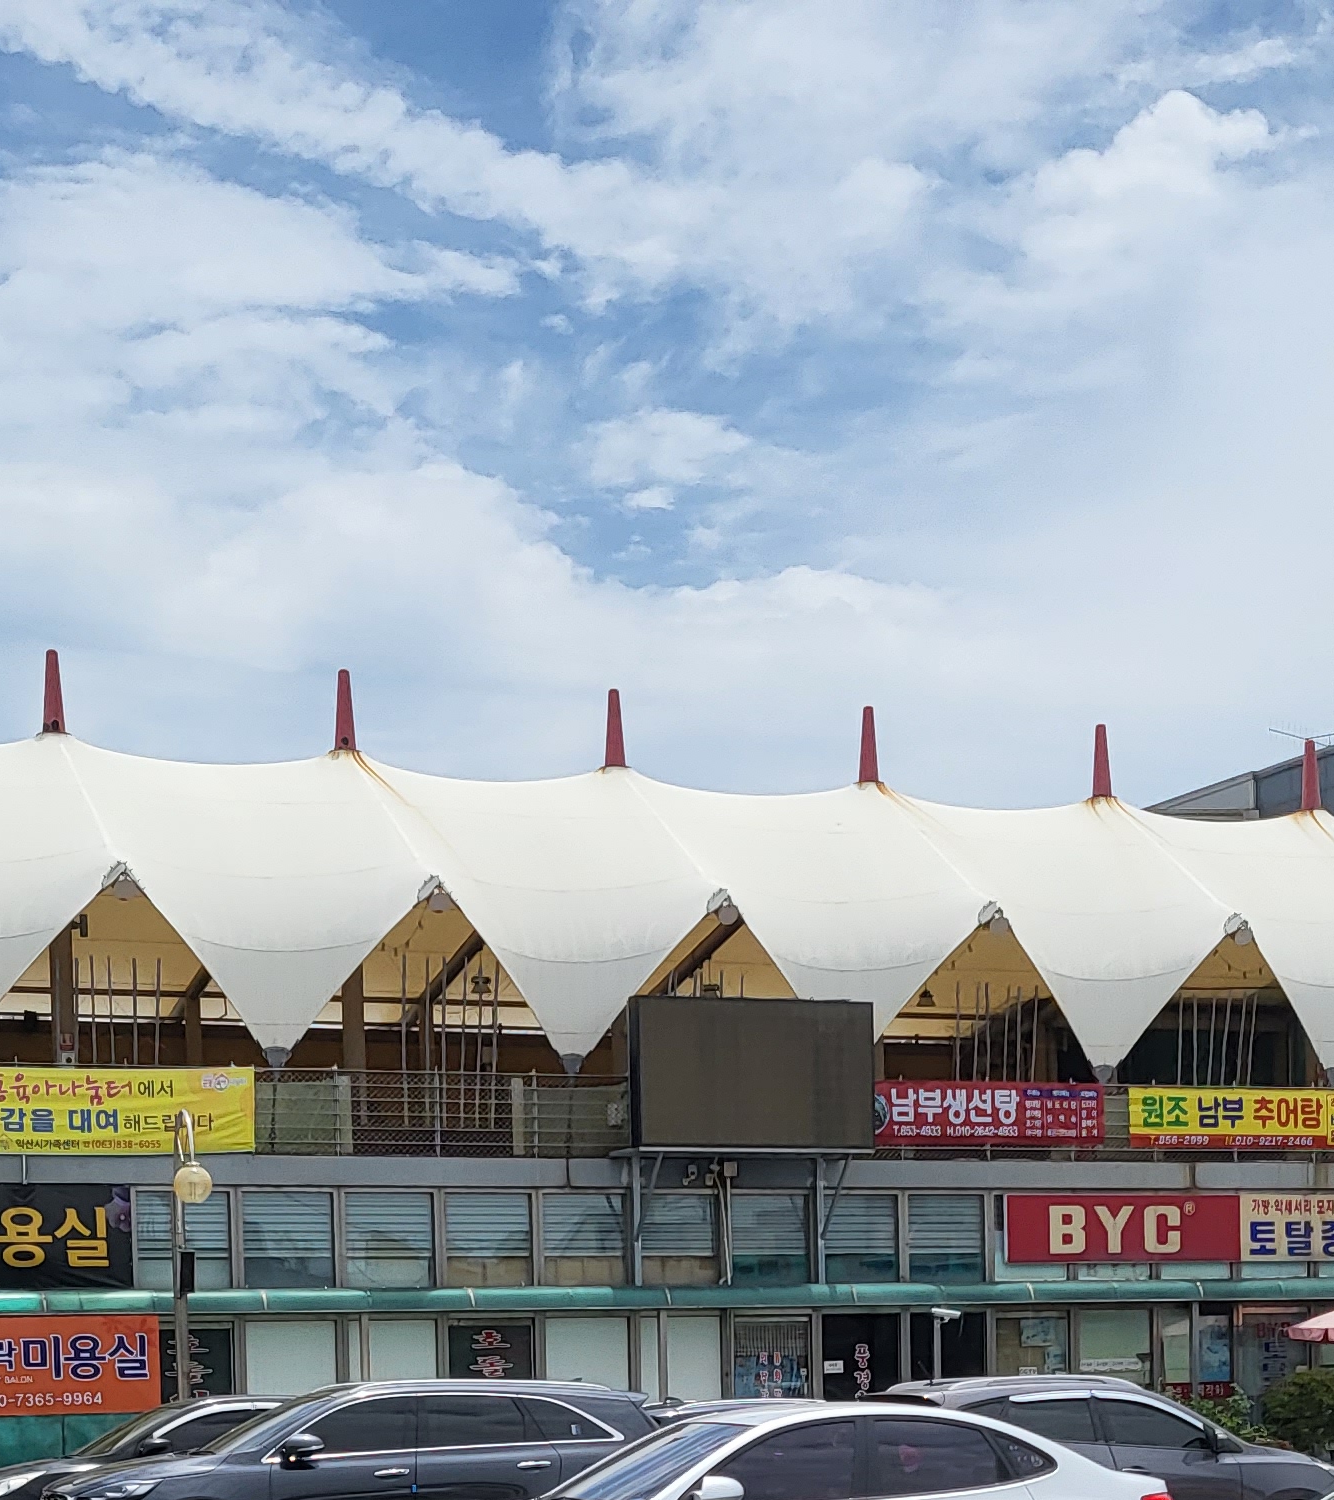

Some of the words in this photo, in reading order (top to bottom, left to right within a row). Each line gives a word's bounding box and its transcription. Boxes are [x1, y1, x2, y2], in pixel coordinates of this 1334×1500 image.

[137, 1080, 174, 1098] 에서
[69, 1107, 119, 1134] 대여
[891, 1088, 1019, 1124] 남부생선탕
[1141, 1096, 1189, 1128] 원조
[1197, 1096, 1244, 1128] 남부
[1253, 1096, 1323, 1129] 추어탕
[16, 1139, 79, 1150] 익산시가족센터
[1048, 1205, 1181, 1254] BYC
[20, 1333, 150, 1380] 미용실
